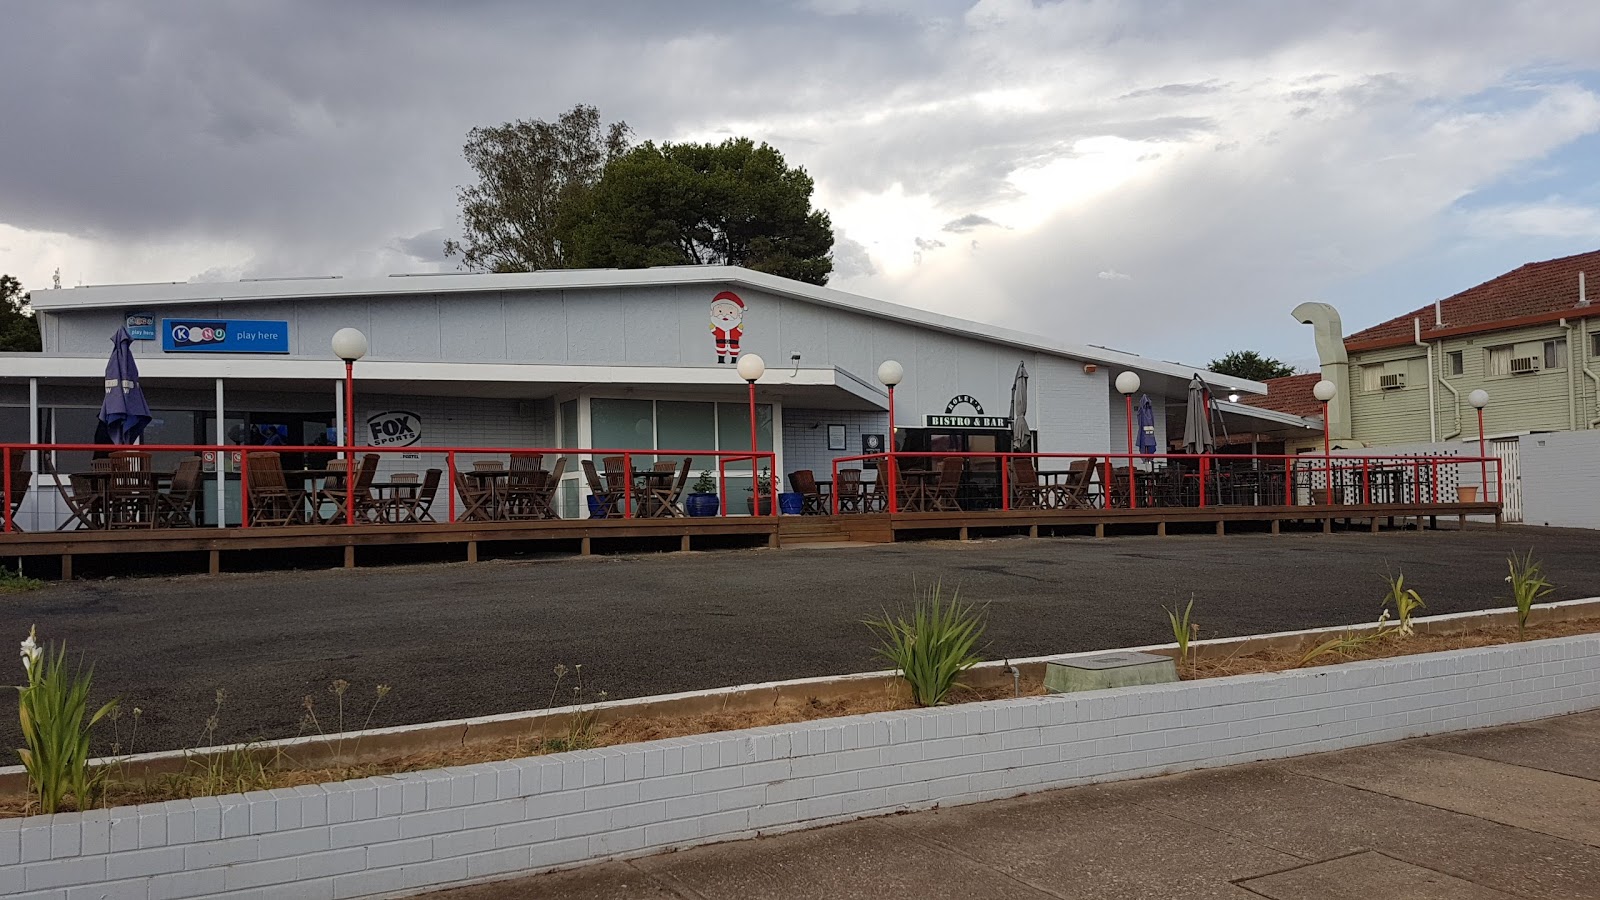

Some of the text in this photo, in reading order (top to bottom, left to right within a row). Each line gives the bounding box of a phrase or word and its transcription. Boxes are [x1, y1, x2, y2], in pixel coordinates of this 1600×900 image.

[174, 326, 225, 342] KNO
[237, 331, 278, 340] play here
[931, 416, 1004, 427] BISTRO & BAR
[370, 416, 413, 440] FOX
[374, 433, 415, 445] SPORTS
